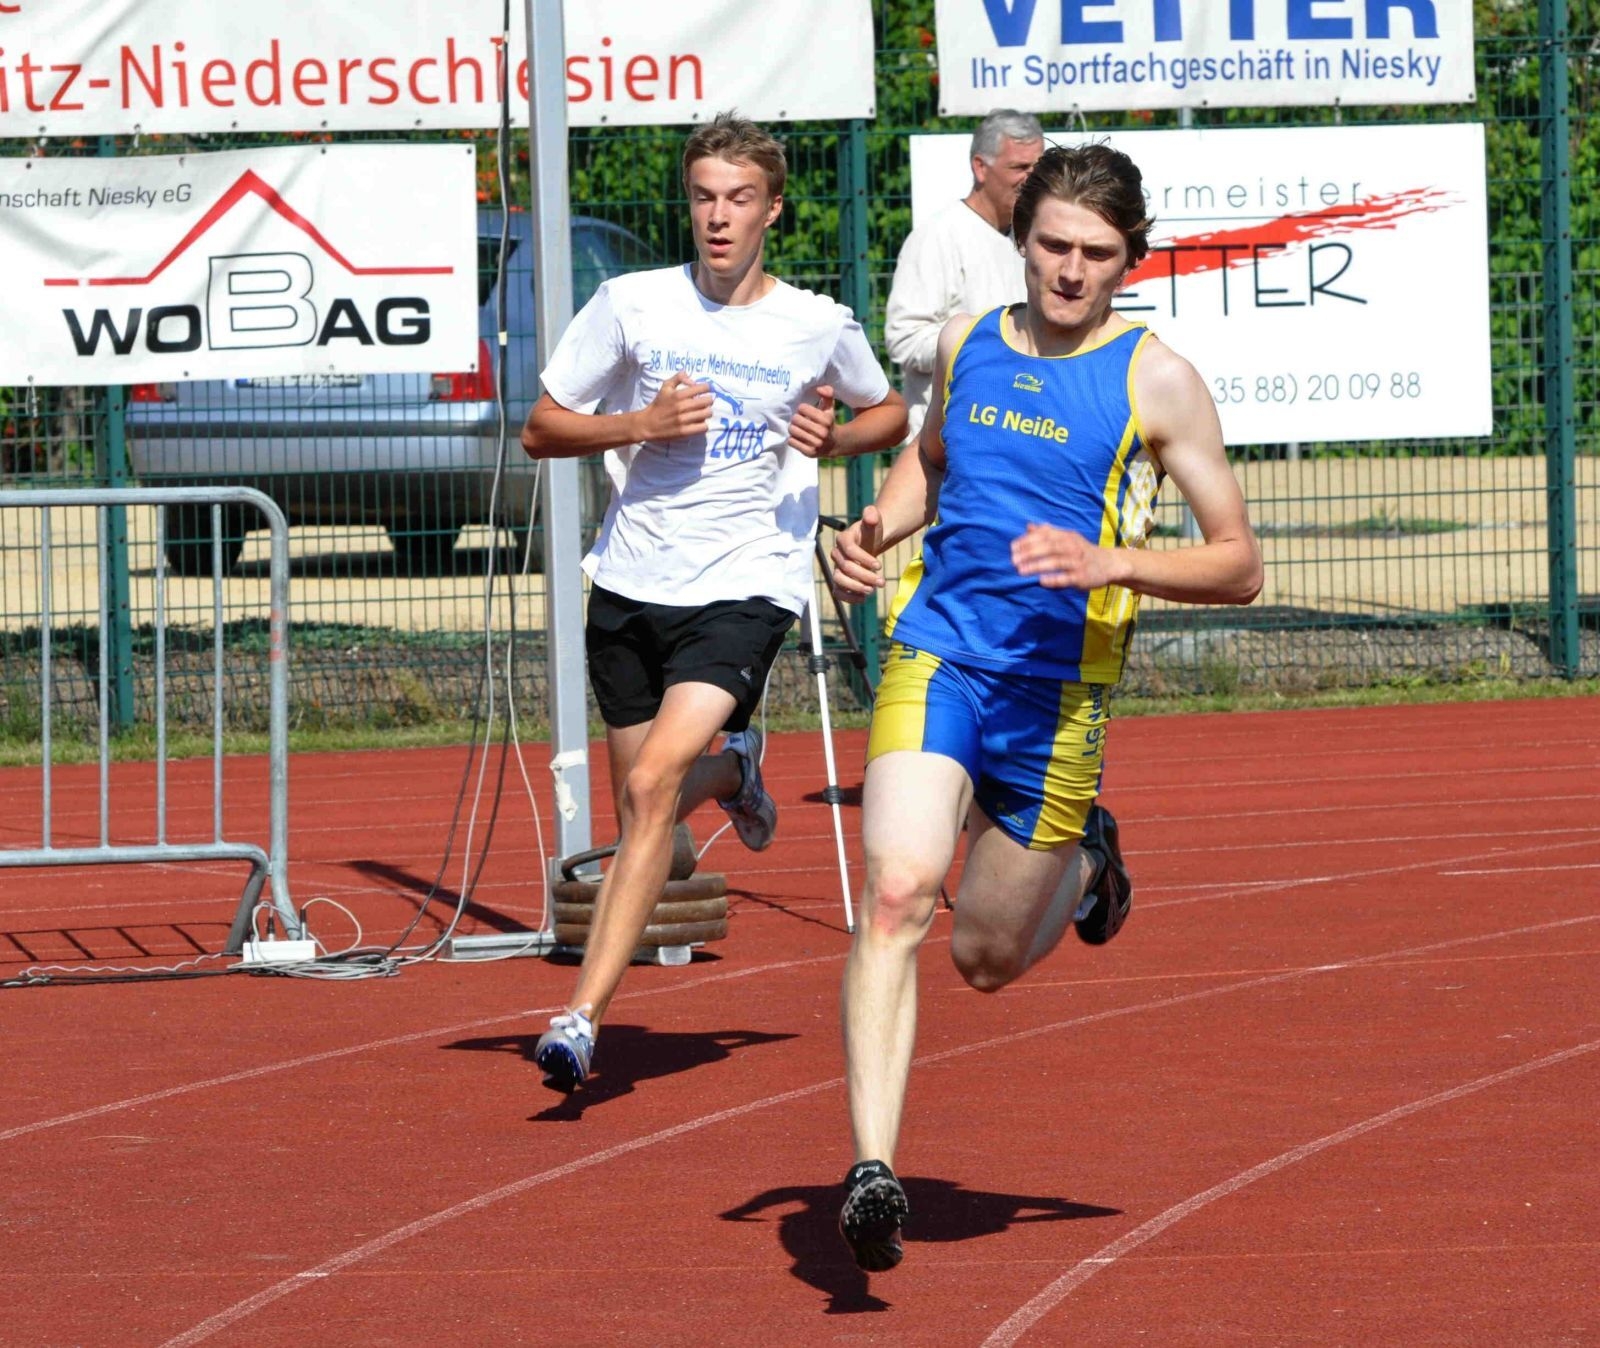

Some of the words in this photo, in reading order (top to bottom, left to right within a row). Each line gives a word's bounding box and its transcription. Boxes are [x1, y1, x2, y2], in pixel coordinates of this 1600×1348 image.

[972, 57, 1012, 88] Ihr
[1023, 49, 1295, 93] Sportfachgeschäft
[1304, 50, 1330, 79] in
[1341, 48, 1441, 87] Niesky
[88, 185, 157, 208] Niesky
[162, 184, 192, 203] eG
[62, 252, 431, 356] WOBAG
[649, 350, 664, 371] 38.
[665, 350, 707, 377] Nieskyer
[708, 353, 791, 392] Mehrkampfmeeting
[1213, 377, 1245, 404] 35
[1254, 373, 1298, 405] 88)
[1307, 374, 1340, 401] 20
[1348, 372, 1381, 400] 09
[1390, 371, 1422, 399] 88
[709, 416, 768, 461] 2008
[969, 403, 998, 427] LG
[1002, 409, 1069, 444] Neiße
